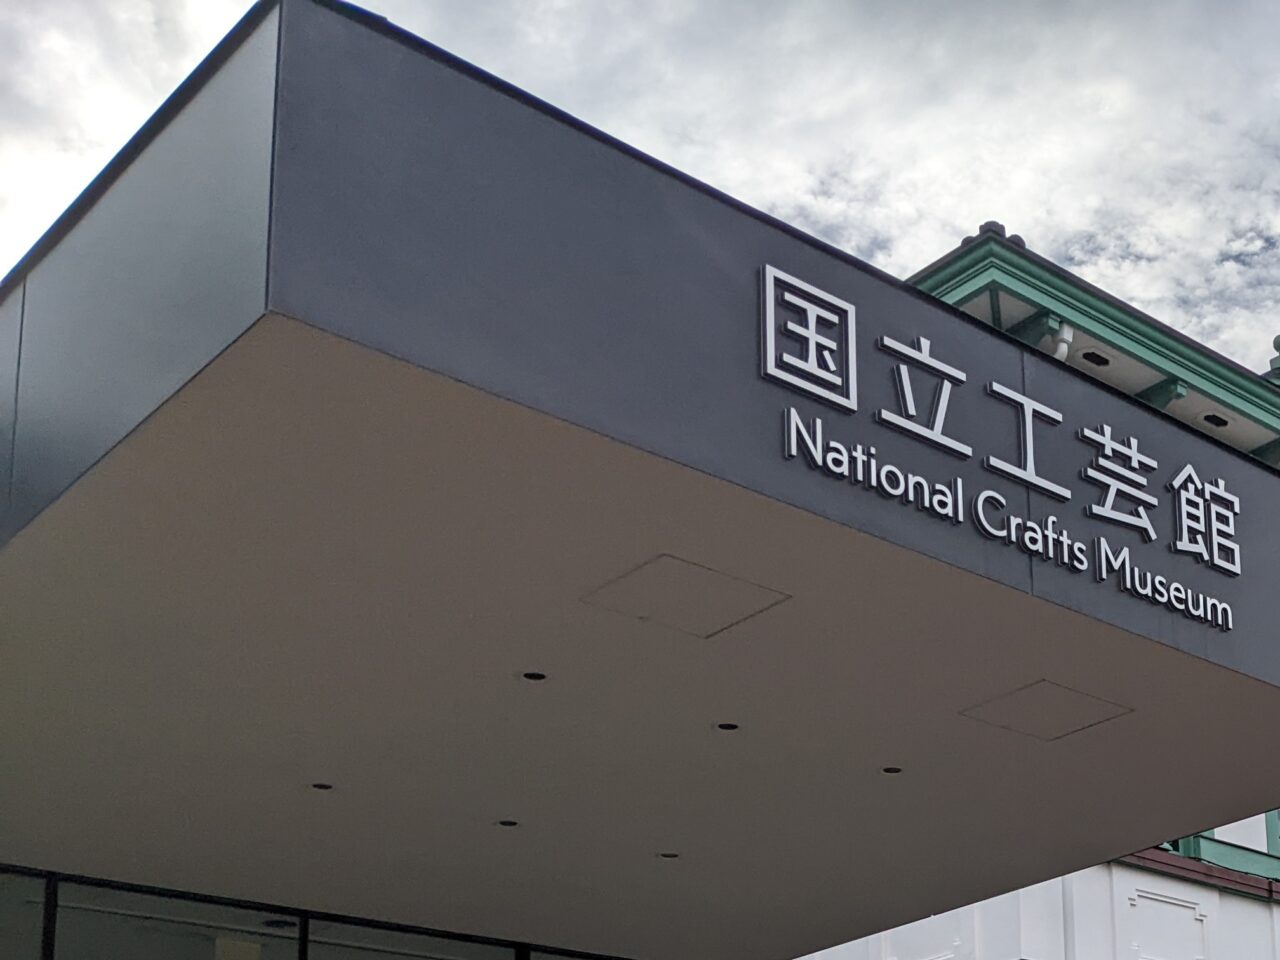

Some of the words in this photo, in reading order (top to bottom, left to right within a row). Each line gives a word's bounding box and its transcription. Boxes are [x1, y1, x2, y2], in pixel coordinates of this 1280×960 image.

[763, 264, 1242, 577] 国立工芸館
[786, 407, 965, 523] National
[974, 490, 1089, 574] Crafts
[1097, 537, 1234, 631] Museum
